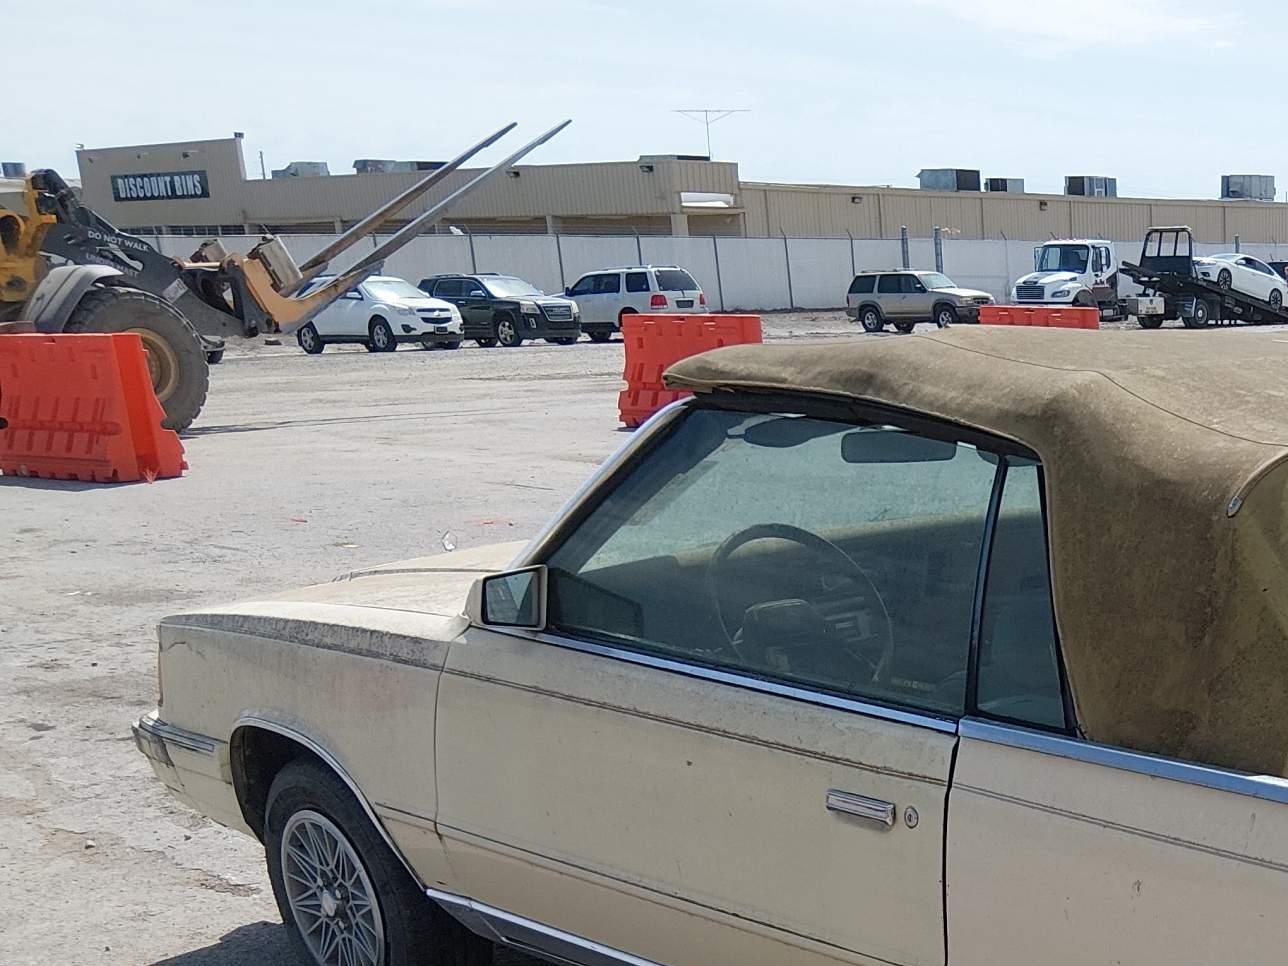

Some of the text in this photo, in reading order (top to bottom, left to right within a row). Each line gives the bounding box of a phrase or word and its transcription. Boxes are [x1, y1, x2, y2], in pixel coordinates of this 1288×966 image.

[116, 174, 203, 198] DISCOUNT BINS
[87, 230, 149, 252] DO NOT WALK
